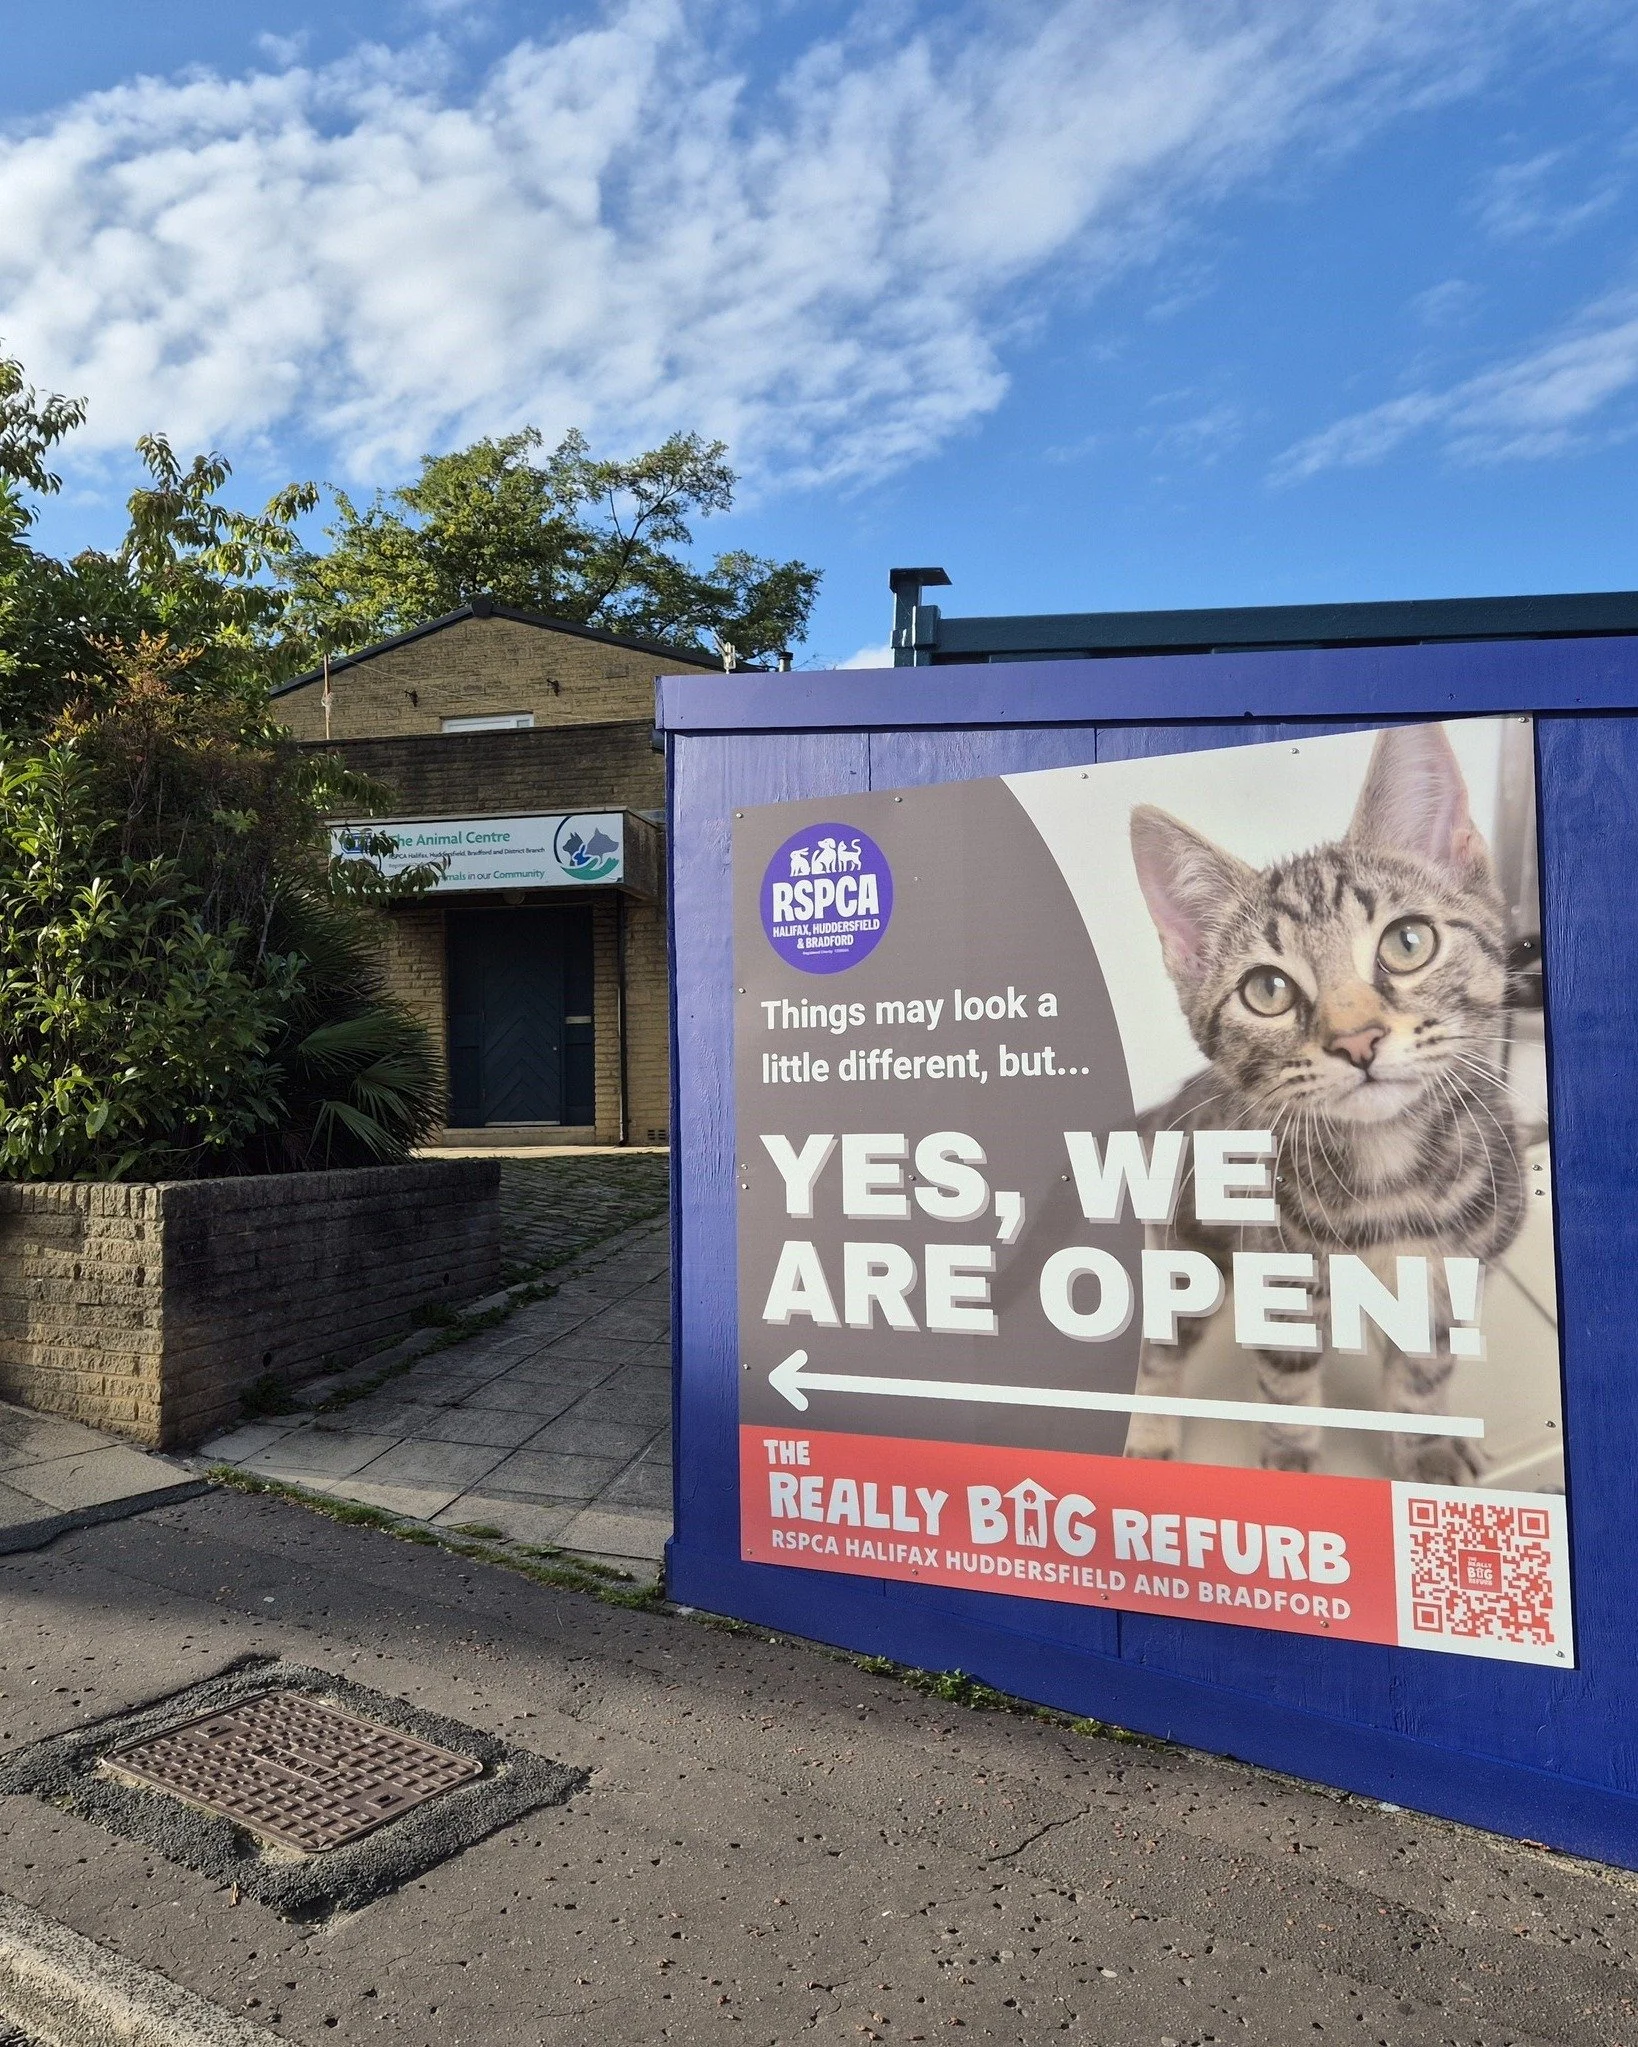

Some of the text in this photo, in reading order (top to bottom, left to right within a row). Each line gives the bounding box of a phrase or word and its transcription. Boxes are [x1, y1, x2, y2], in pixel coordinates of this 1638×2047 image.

[416, 831, 462, 847] Animal
[465, 831, 510, 844] Centre
[468, 871, 476, 880] in
[477, 872, 491, 880] our
[493, 869, 545, 880] Community
[773, 874, 879, 923] RSPCA
[773, 919, 880, 937] HALIFAX, HUDDERSFIELD
[797, 934, 854, 949] & BRADFORD
[761, 986, 1058, 1034] Things may look a
[762, 1044, 1090, 1084] little different, but...
[759, 1130, 1280, 1242] YES, WE
[762, 1240, 1485, 1358] ARE OPEN!
[763, 1439, 810, 1466] THE
[769, 1471, 1351, 1585] REALLY BIG REFURB
[772, 1529, 1351, 1620] RSPCA HALIFAX HUDDERSFIELD AND BRADFORD
